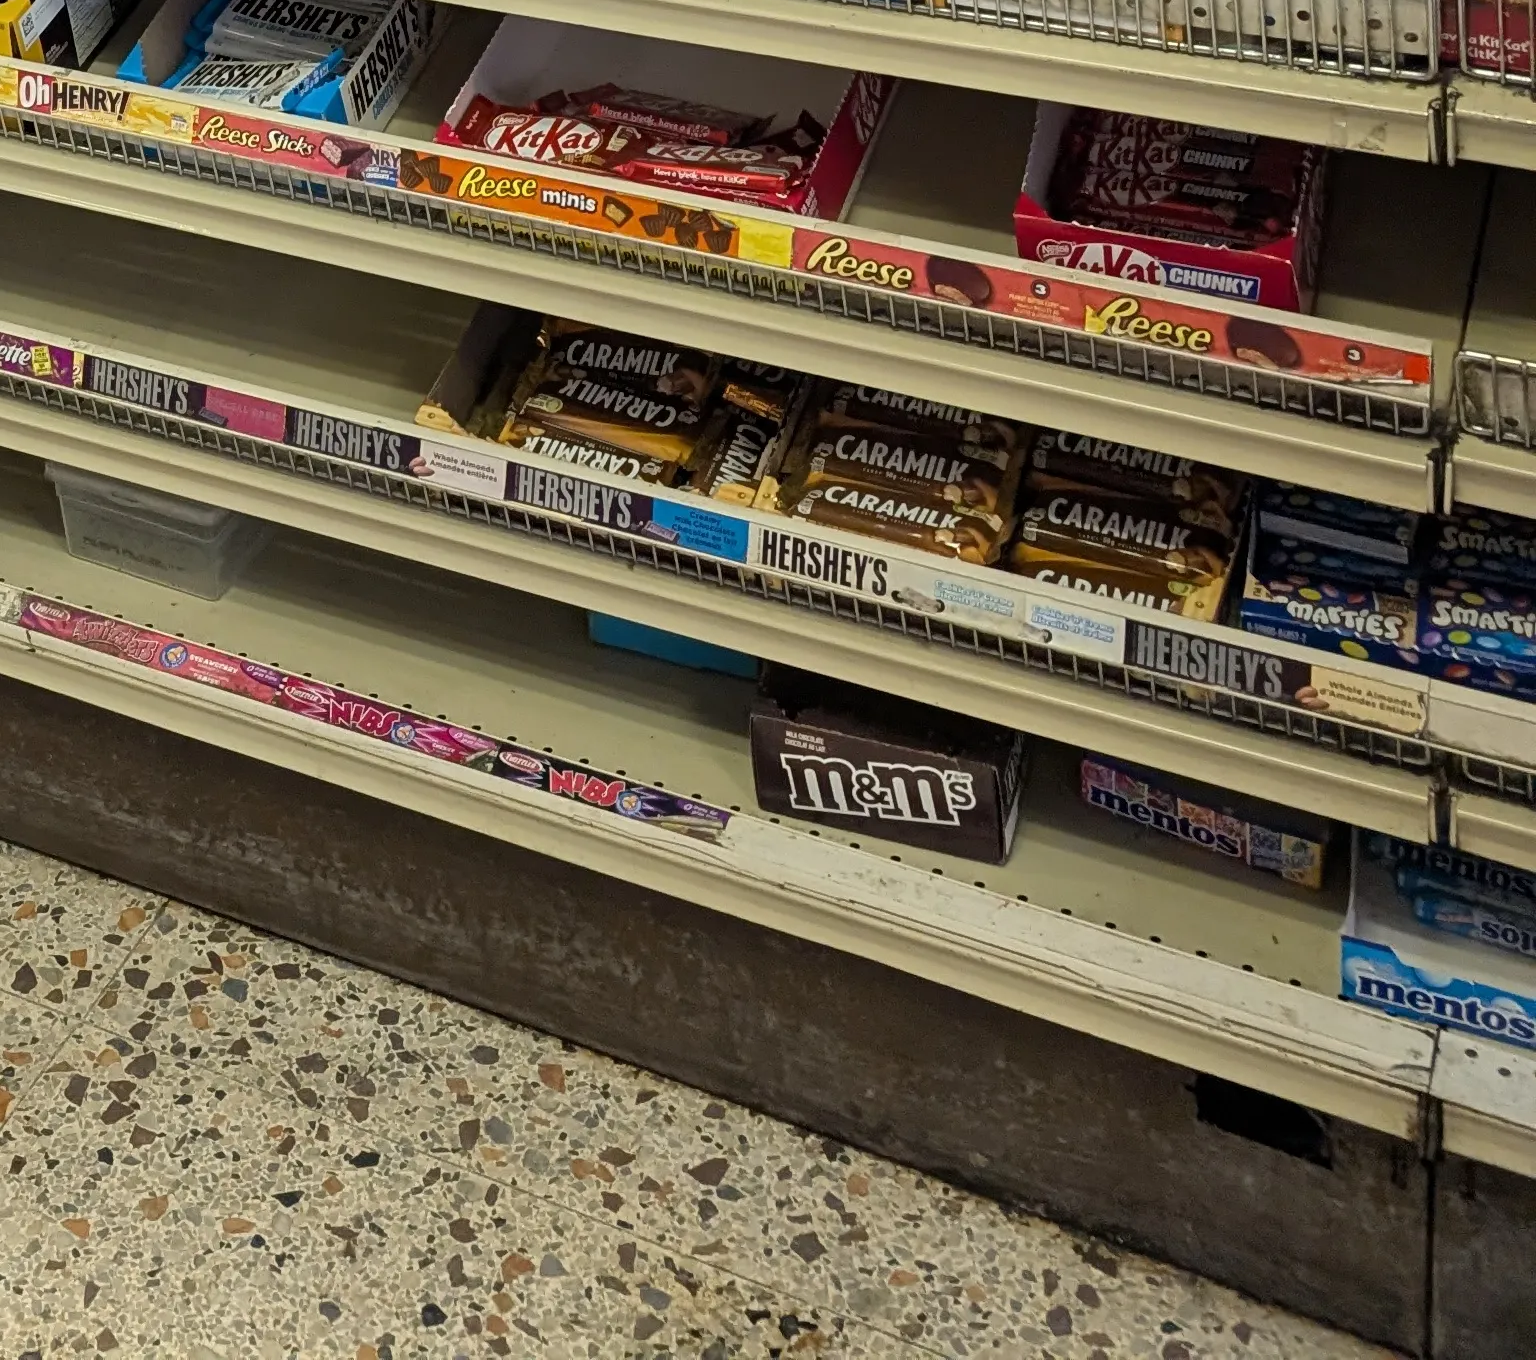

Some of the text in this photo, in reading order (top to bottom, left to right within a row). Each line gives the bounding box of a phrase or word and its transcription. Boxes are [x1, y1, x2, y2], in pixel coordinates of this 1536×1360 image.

[19, 75, 130, 121] Oh HENRY!
[198, 114, 315, 158] Reese Sticks
[458, 166, 598, 214] Reese minis
[806, 236, 913, 290] Reese
[1168, 266, 1255, 297] CHUNKY
[566, 338, 680, 377] CARAMILK
[92, 358, 189, 414] HERSHEY'S
[1046, 497, 1192, 551] CARAMILK
[761, 530, 888, 597] HERSHEY'S
[1136, 625, 1283, 699] HERSHEY'S
[328, 699, 400, 735] NIBS
[549, 768, 626, 807] NIBS
[781, 752, 975, 827] m&m's
[1089, 781, 1243, 857] mentos
[1356, 972, 1536, 1041] mentos
